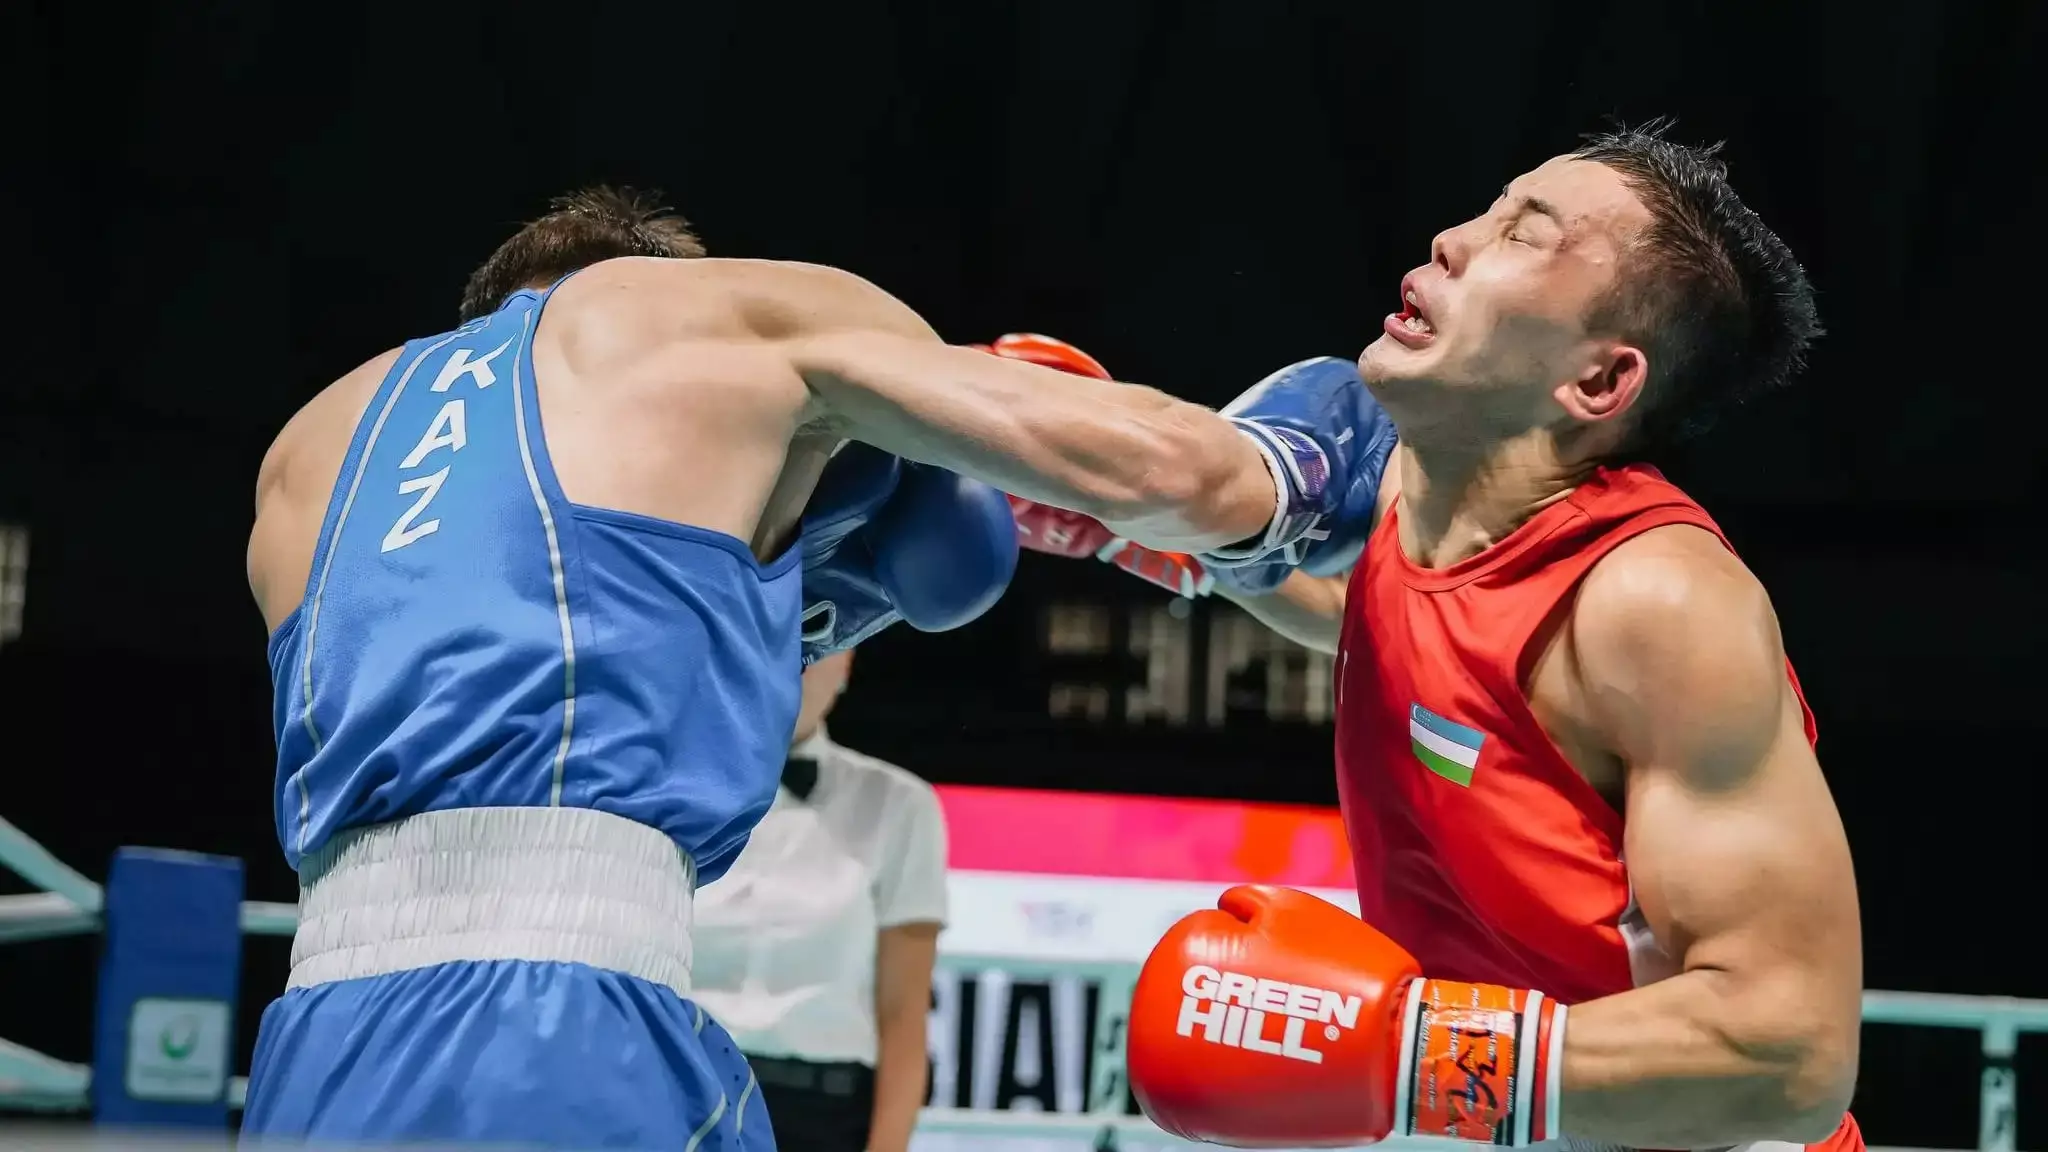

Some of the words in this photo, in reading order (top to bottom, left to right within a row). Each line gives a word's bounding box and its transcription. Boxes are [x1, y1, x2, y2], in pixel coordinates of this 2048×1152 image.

[381, 333, 516, 553] KAZ
[1176, 995, 1323, 1064] HILL
[1182, 965, 1362, 1029] GREEN
